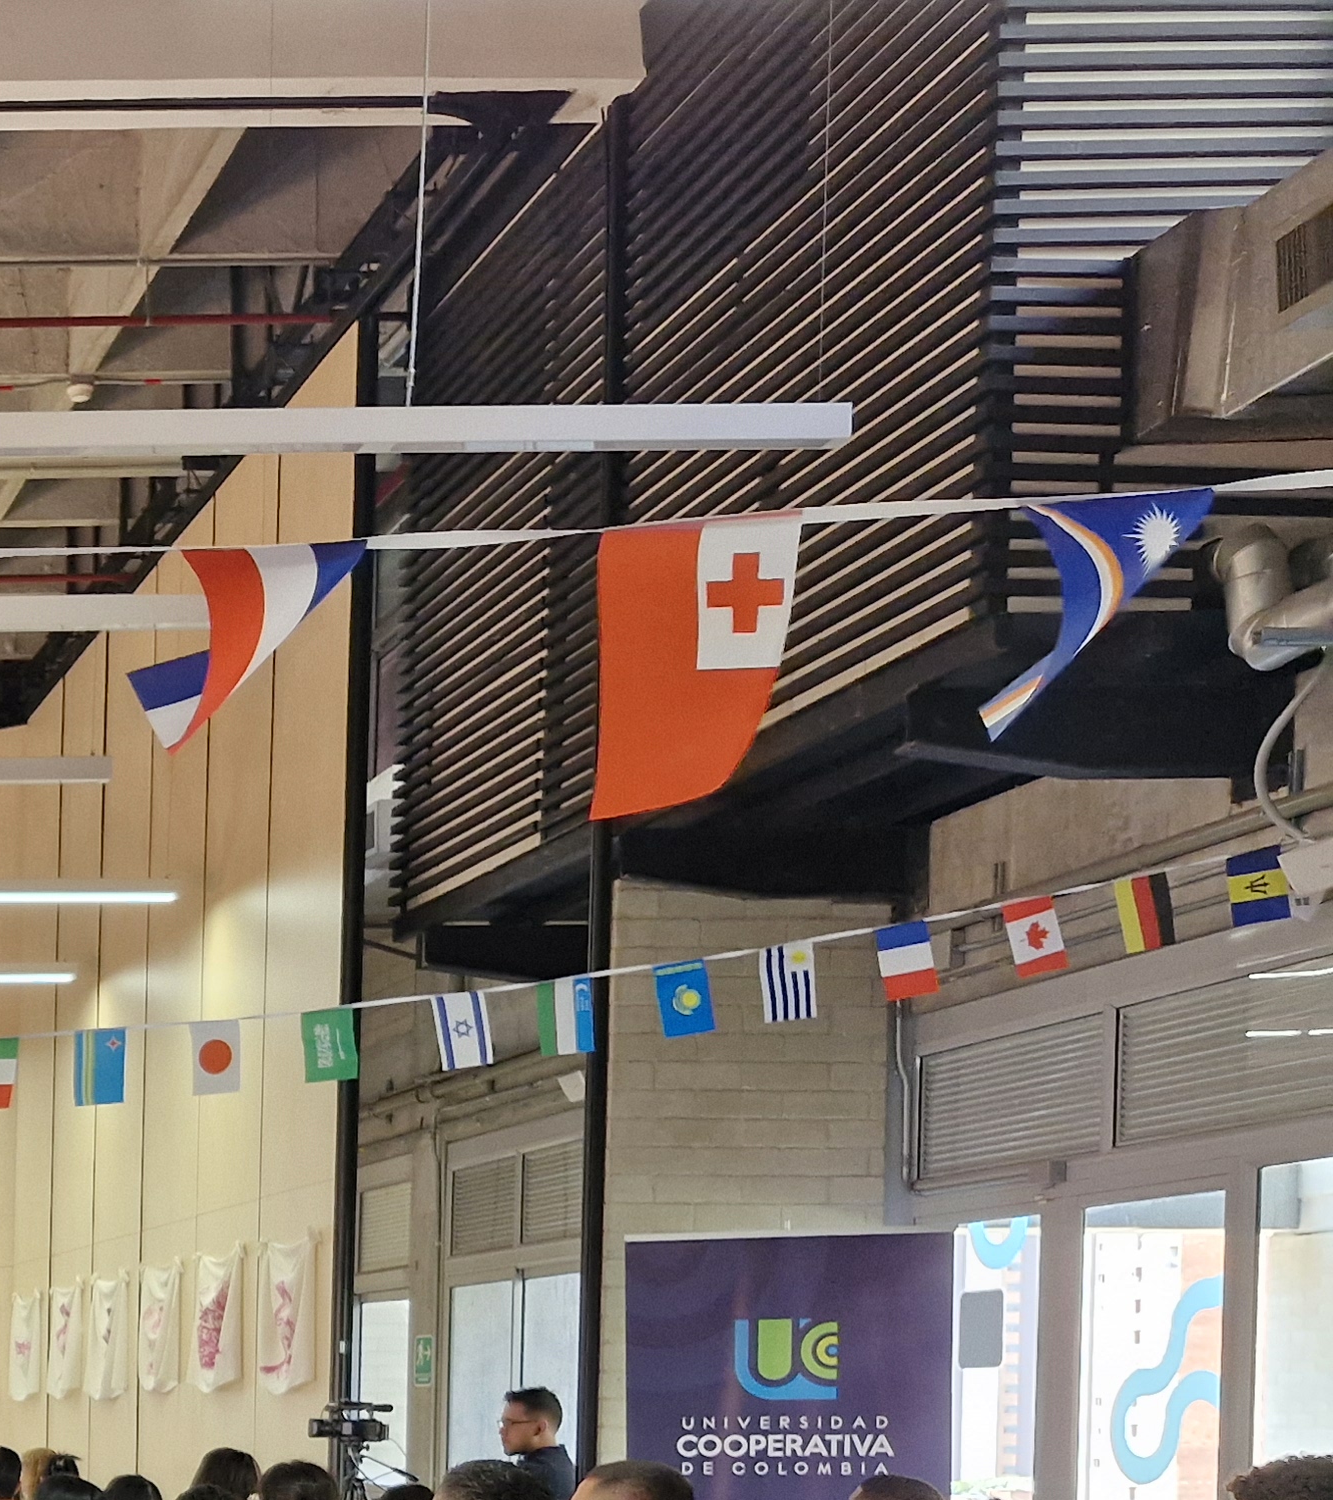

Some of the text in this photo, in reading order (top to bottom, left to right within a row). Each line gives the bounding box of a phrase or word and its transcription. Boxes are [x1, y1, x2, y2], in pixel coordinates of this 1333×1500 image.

[681, 1415, 889, 1430] UNIVERSIDAD
[676, 1434, 895, 1458] COOPERATIVA
[681, 1461, 890, 1476] DE COLOMBIA
